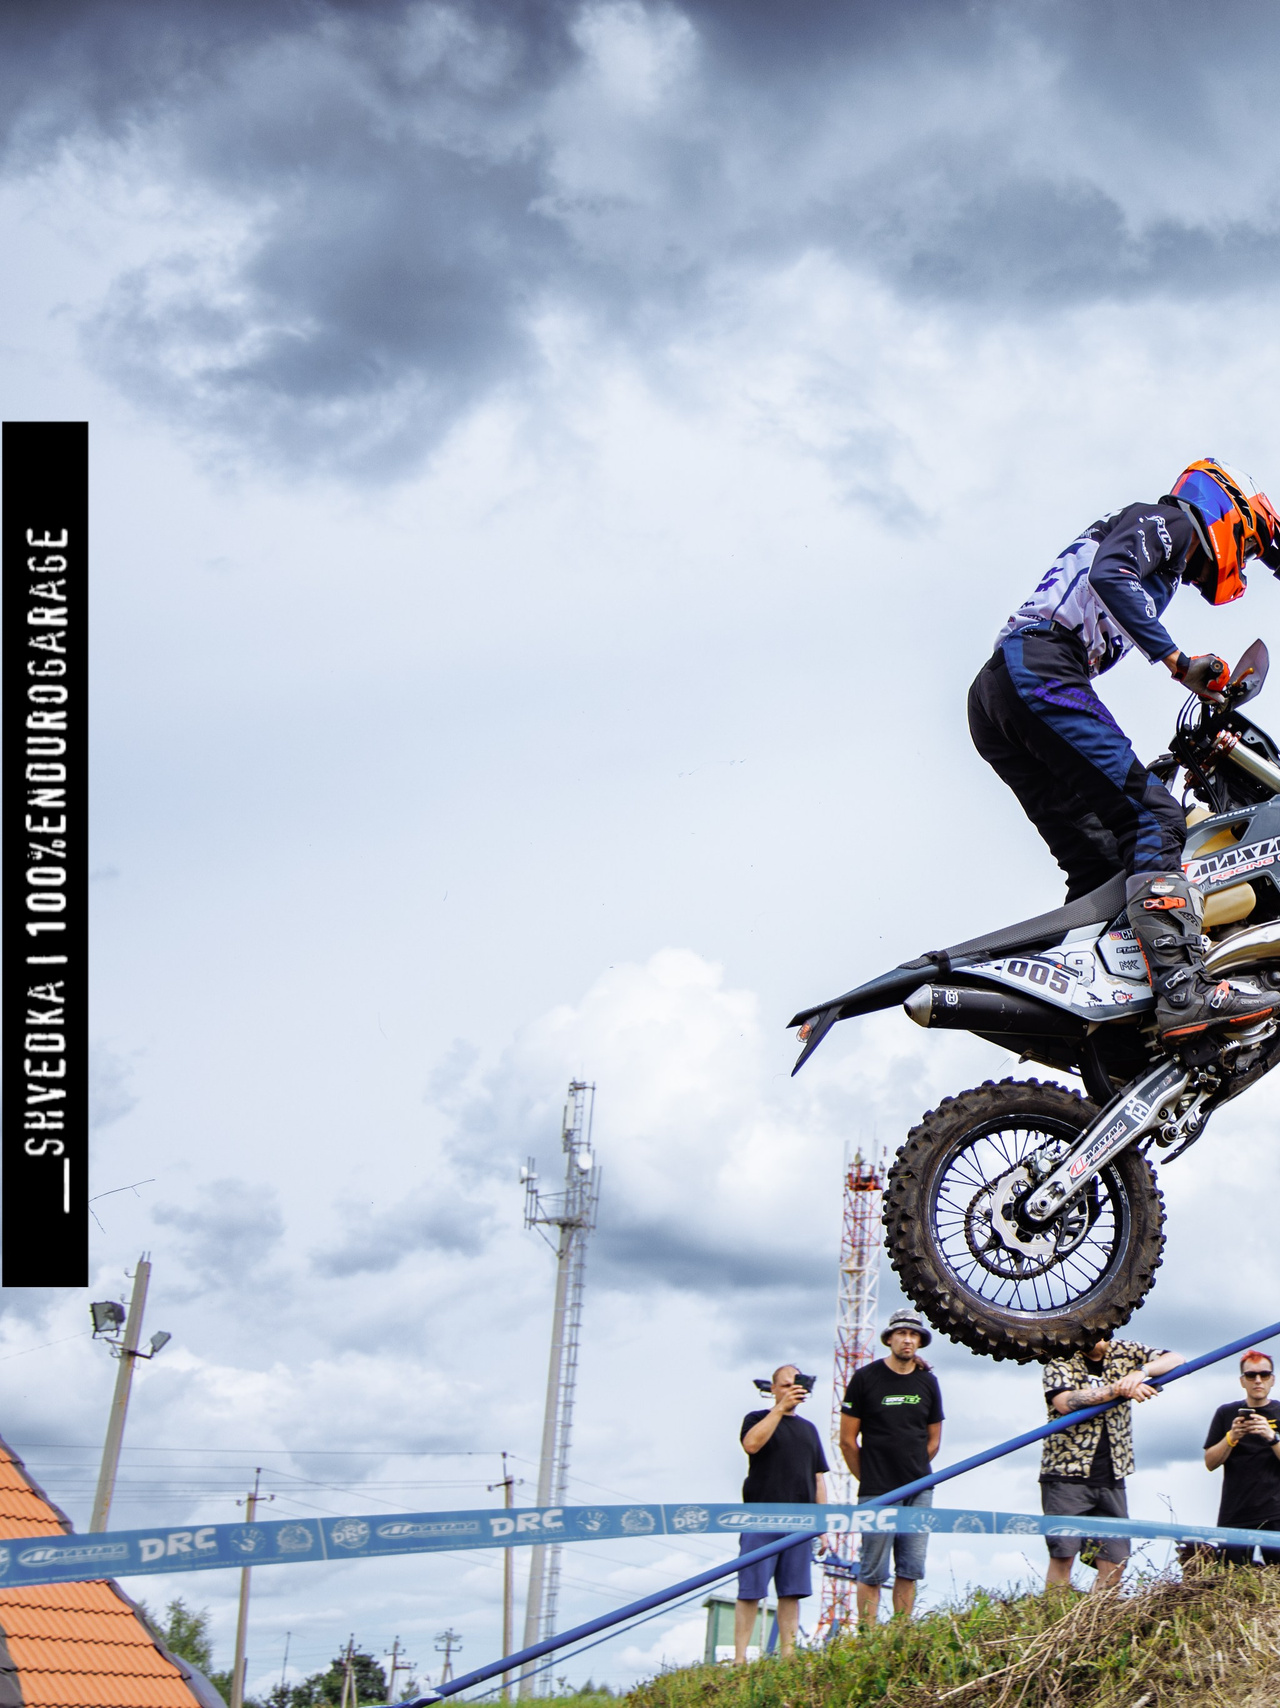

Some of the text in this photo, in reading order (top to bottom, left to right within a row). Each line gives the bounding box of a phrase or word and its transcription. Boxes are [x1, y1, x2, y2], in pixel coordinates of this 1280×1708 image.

[1210, 856, 1275, 883] RACING
[1007, 961, 1069, 994] 005
[490, 1508, 564, 1538] DRC
[825, 1508, 898, 1534] DRC
[138, 1527, 217, 1562] DRC
